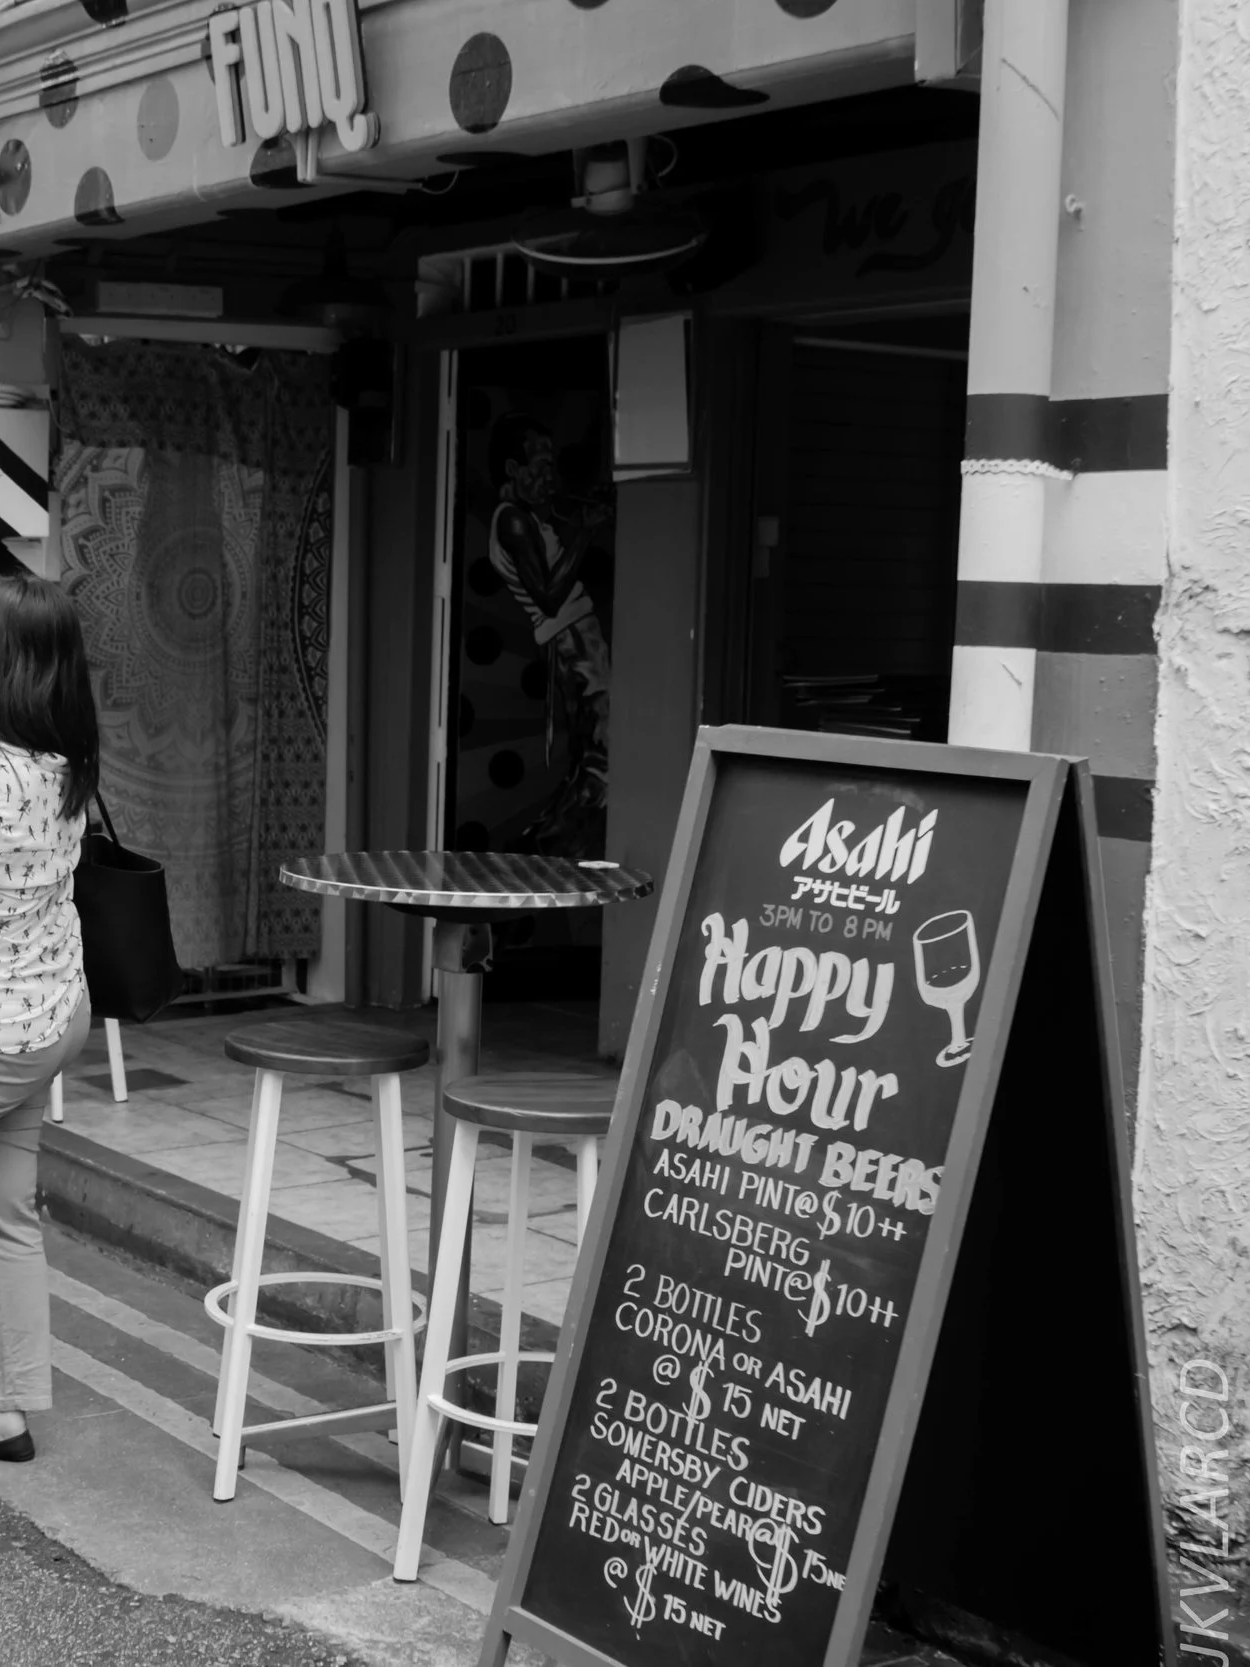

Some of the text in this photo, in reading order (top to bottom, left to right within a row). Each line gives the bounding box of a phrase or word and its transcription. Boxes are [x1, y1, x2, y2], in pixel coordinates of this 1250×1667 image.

[779, 797, 939, 885] Asahi
[791, 875, 901, 915] アサヒビール
[809, 910, 834, 934] TO
[699, 912, 895, 1044] Happy
[712, 1013, 899, 1132] Hour
[651, 1098, 946, 1217] DRAUGHT BEERS
[652, 1148, 731, 1196] ASAHI
[643, 1187, 811, 1267] CARLSBERG
[623, 1263, 763, 1344] 2 BOTTLES
[614, 1301, 852, 1421] CORONA OR ASAHI
[596, 1377, 751, 1472] 2 BOTTLES
[760, 1402, 807, 1441] NET
[590, 1411, 827, 1536] SOMERSBY CIDERS
[593, 1482, 709, 1557] GLASSES
[643, 1535, 710, 1591] WHITE
[713, 1569, 783, 1624] WINES
[689, 1611, 727, 1641] NET
